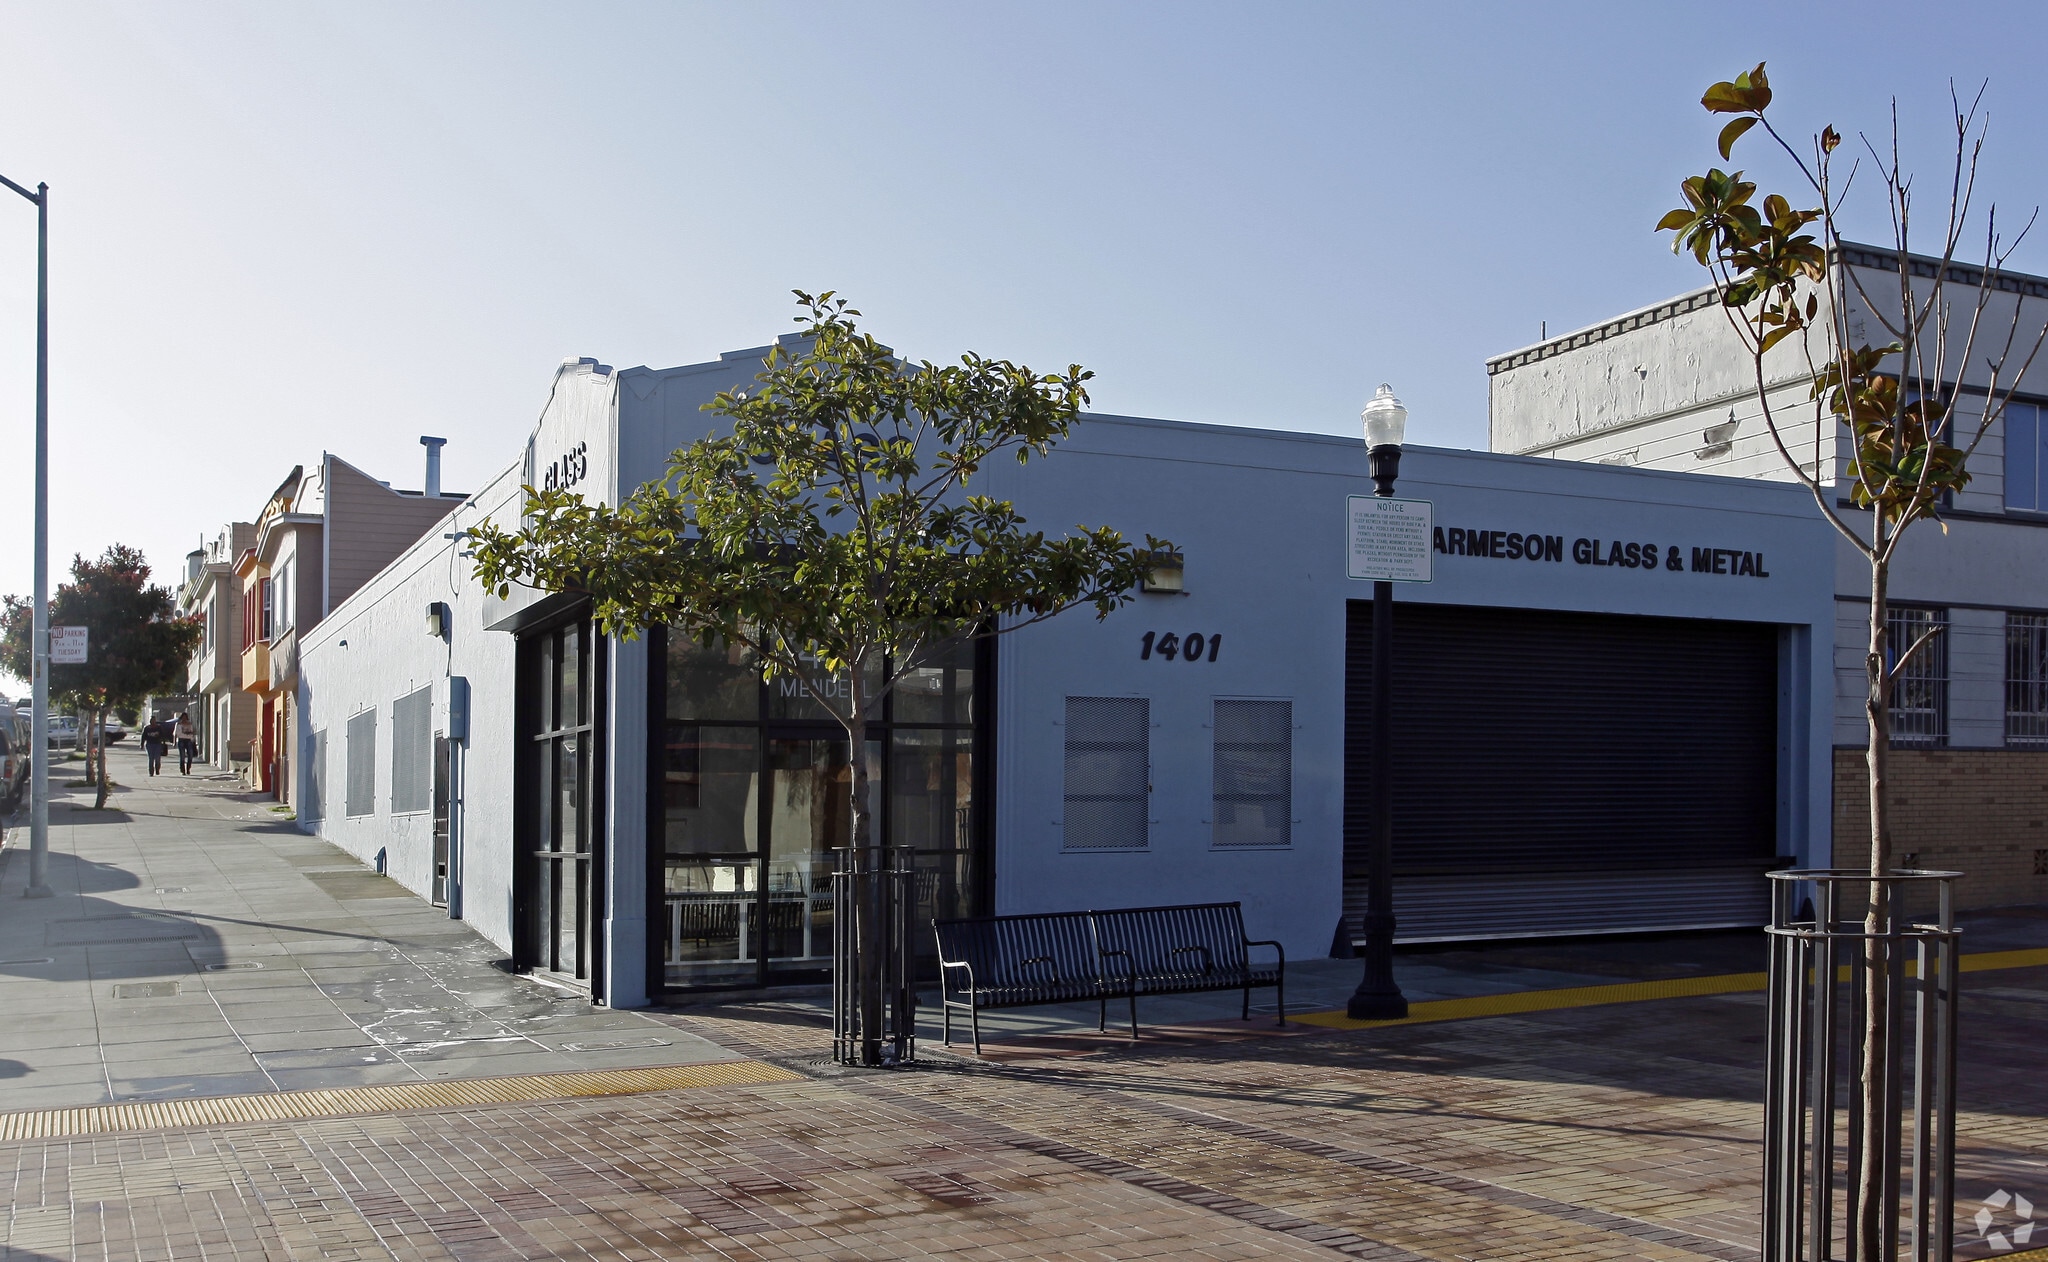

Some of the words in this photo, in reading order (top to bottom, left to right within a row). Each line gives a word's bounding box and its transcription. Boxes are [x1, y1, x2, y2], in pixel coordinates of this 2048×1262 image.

[545, 441, 587, 493] GLASS
[1377, 503, 1404, 512] NOTICE
[1573, 538, 1658, 569] GLASS
[1666, 546, 1683, 571] &
[1691, 547, 1769, 577] METAL
[53, 629, 62, 637] NO
[1141, 631, 1222, 662] 1401
[780, 678, 872, 698] MENDEL
